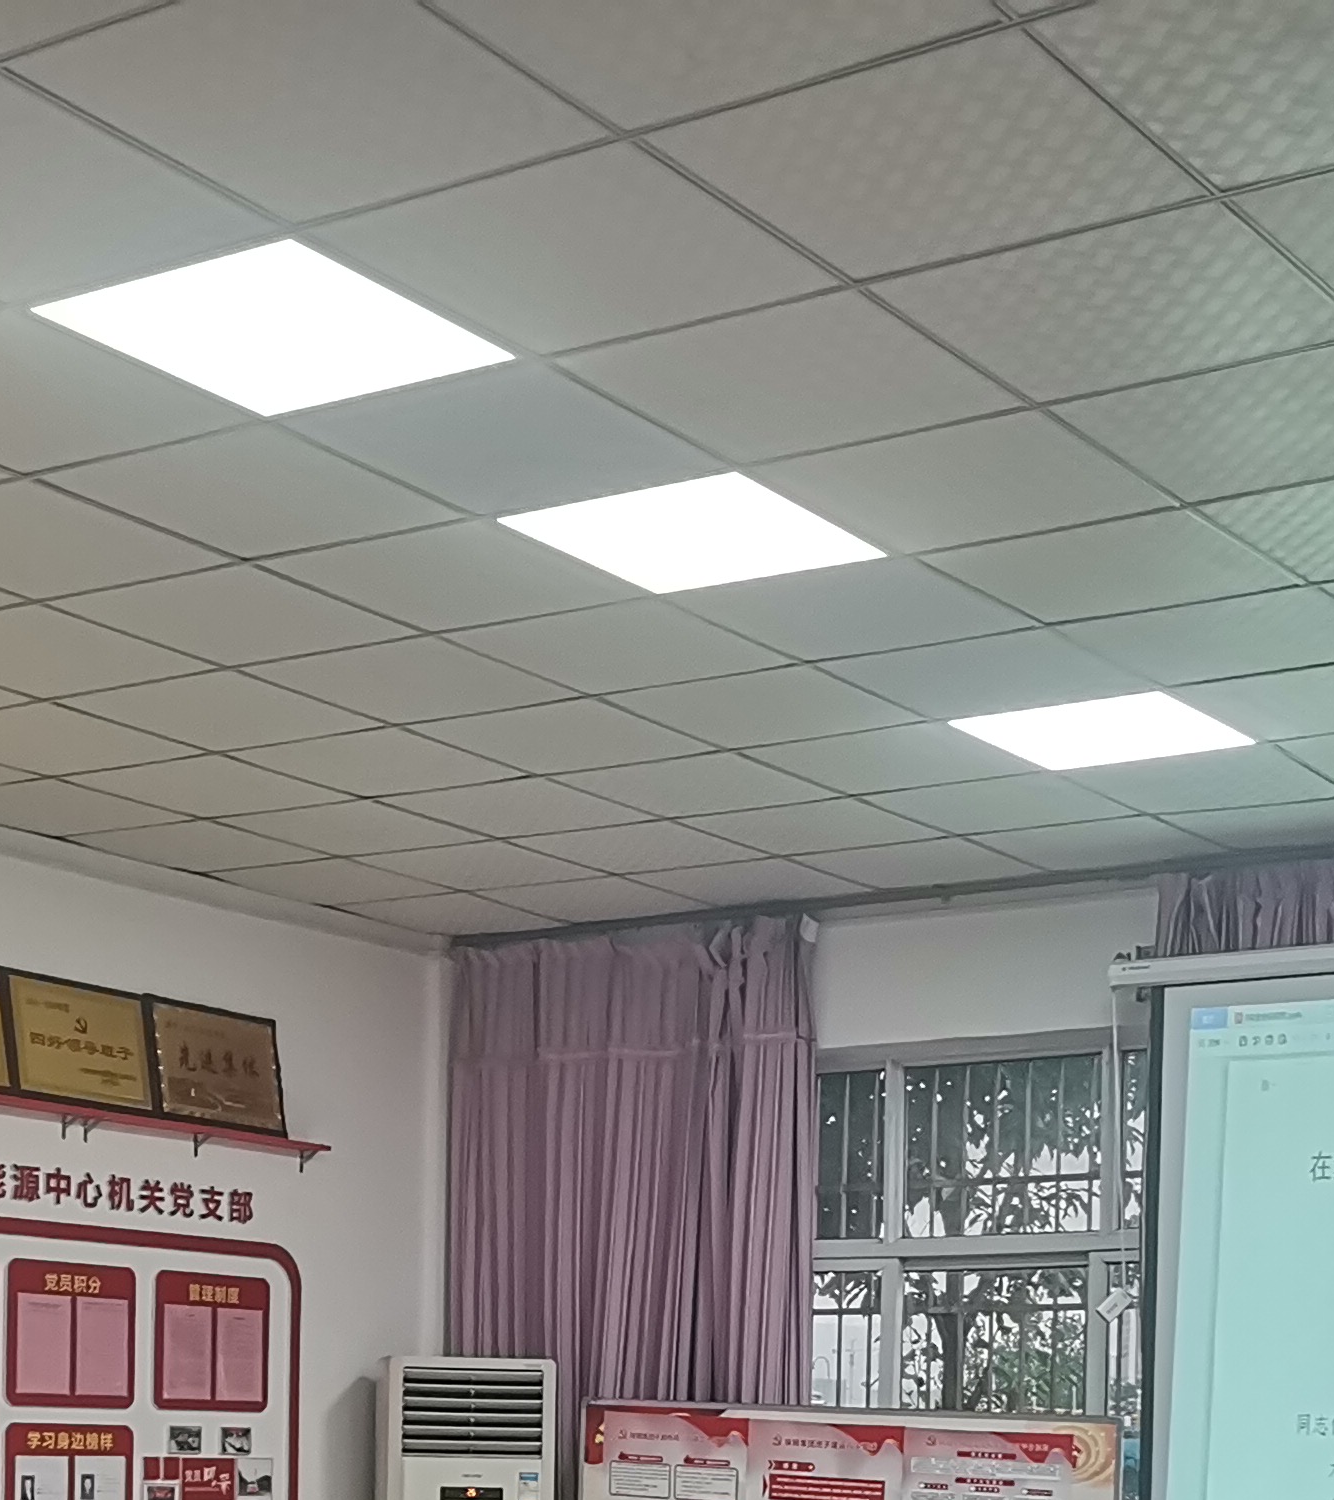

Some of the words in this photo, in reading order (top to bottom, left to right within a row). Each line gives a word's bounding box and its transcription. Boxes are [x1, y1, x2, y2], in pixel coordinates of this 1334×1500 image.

[44, 1272, 102, 1295] 党员积分
[27, 1431, 114, 1452] 学习身边榜样
